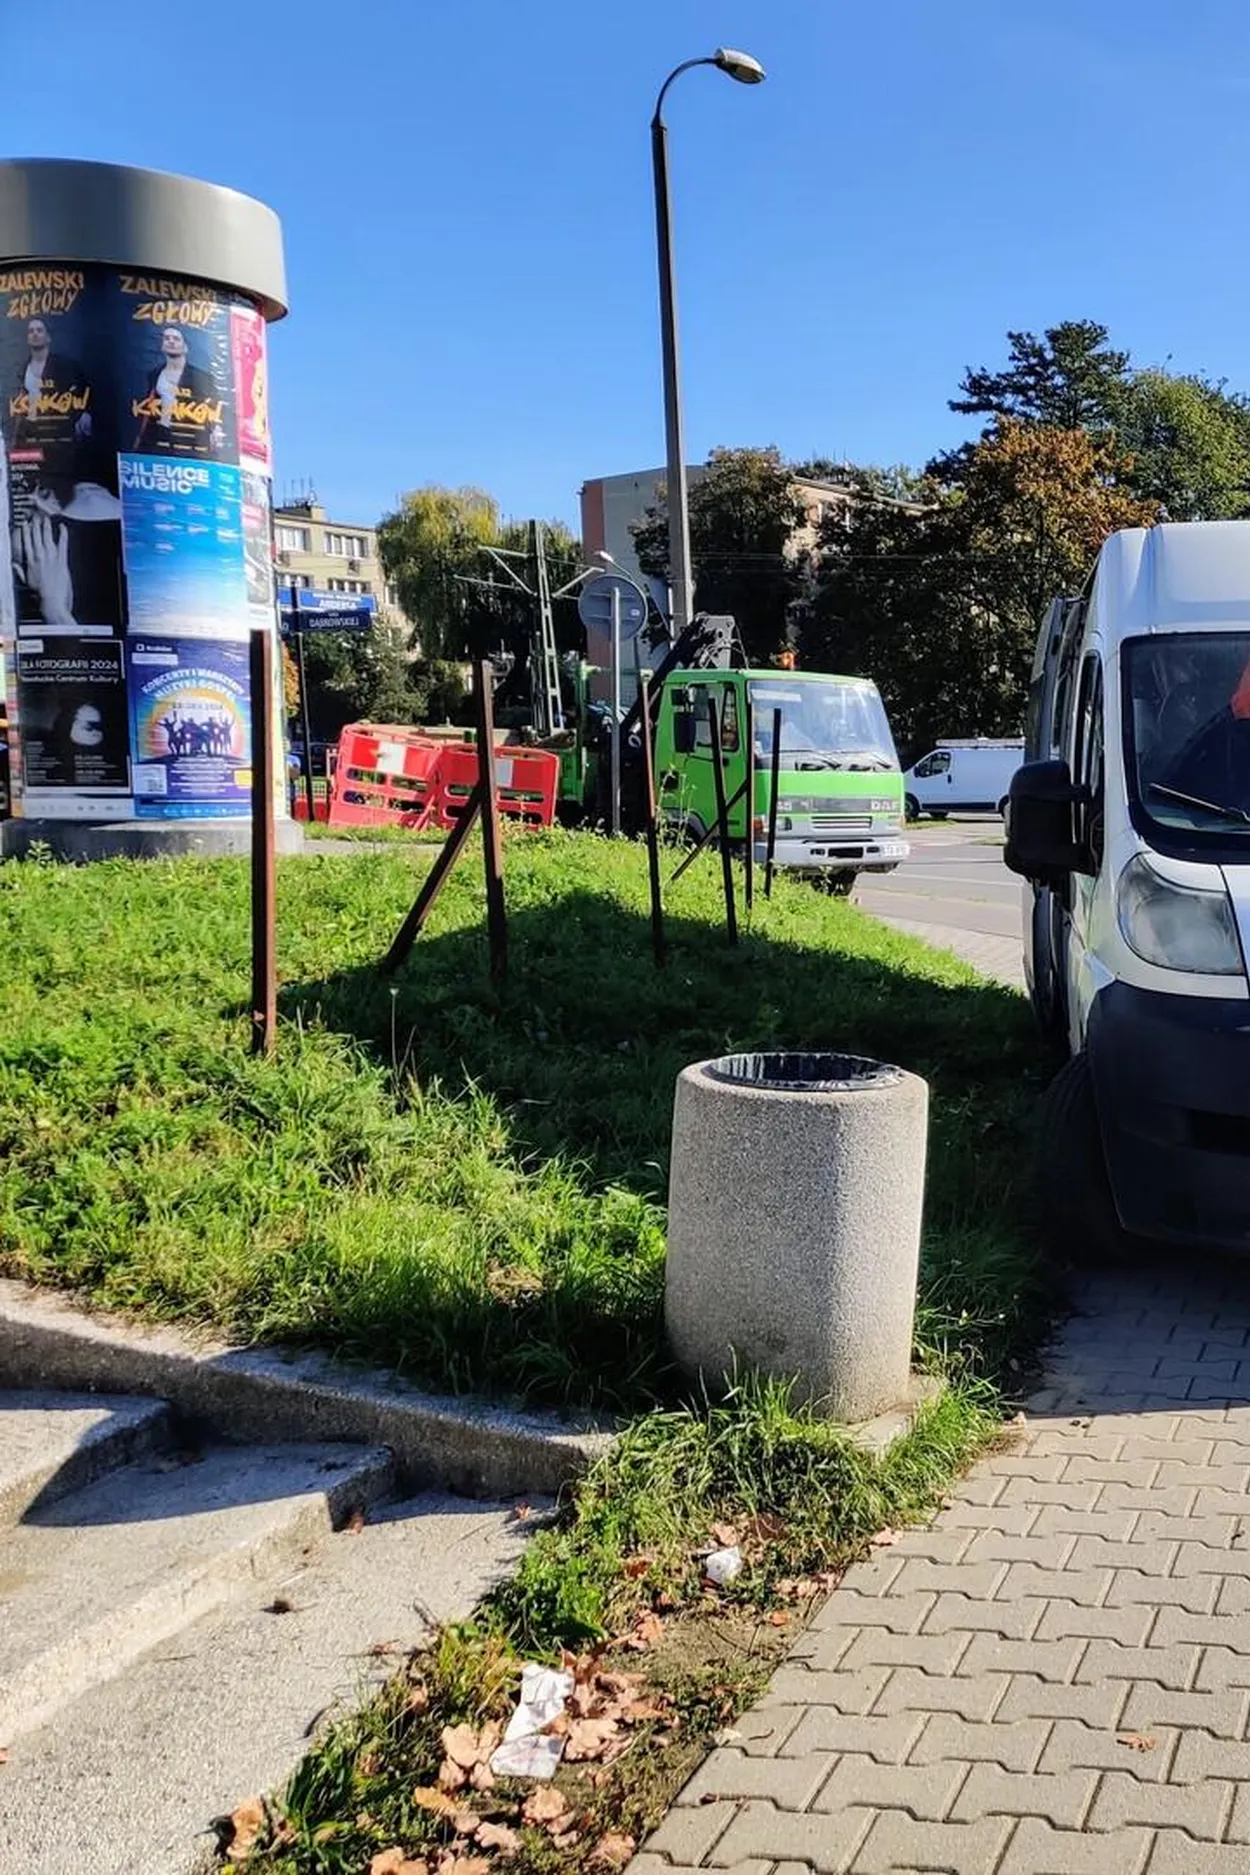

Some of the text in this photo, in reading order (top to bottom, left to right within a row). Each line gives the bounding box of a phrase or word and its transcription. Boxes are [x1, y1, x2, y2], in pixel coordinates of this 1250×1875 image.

[0, 272, 84, 292] ZALEWSKI
[119, 275, 216, 301] ZALEWSKI
[120, 461, 209, 483] SILENCE
[122, 475, 193, 495] MUSIC
[90, 660, 119, 669] 2024
[871, 800, 899, 810] DAF
